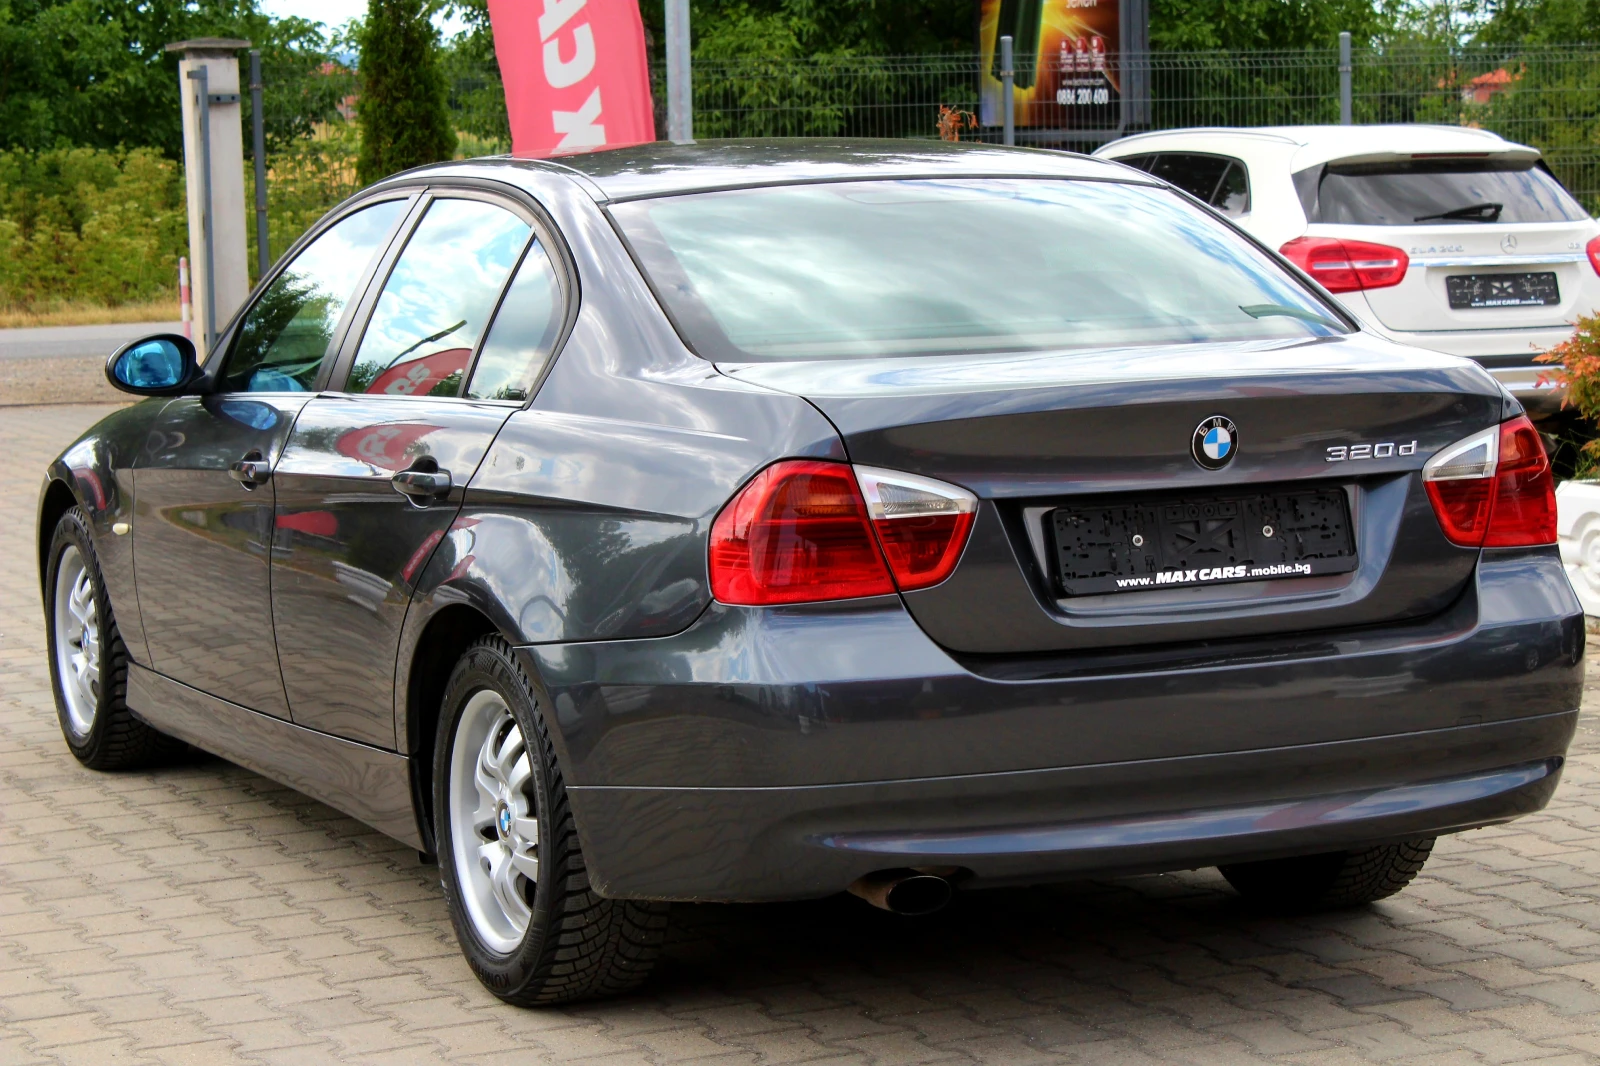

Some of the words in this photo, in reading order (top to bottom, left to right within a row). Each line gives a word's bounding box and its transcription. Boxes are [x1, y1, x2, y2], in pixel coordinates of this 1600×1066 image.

[1077, 88, 1092, 104] 200
[1198, 417, 1236, 437] BMW
[1325, 440, 1418, 463] 320d
